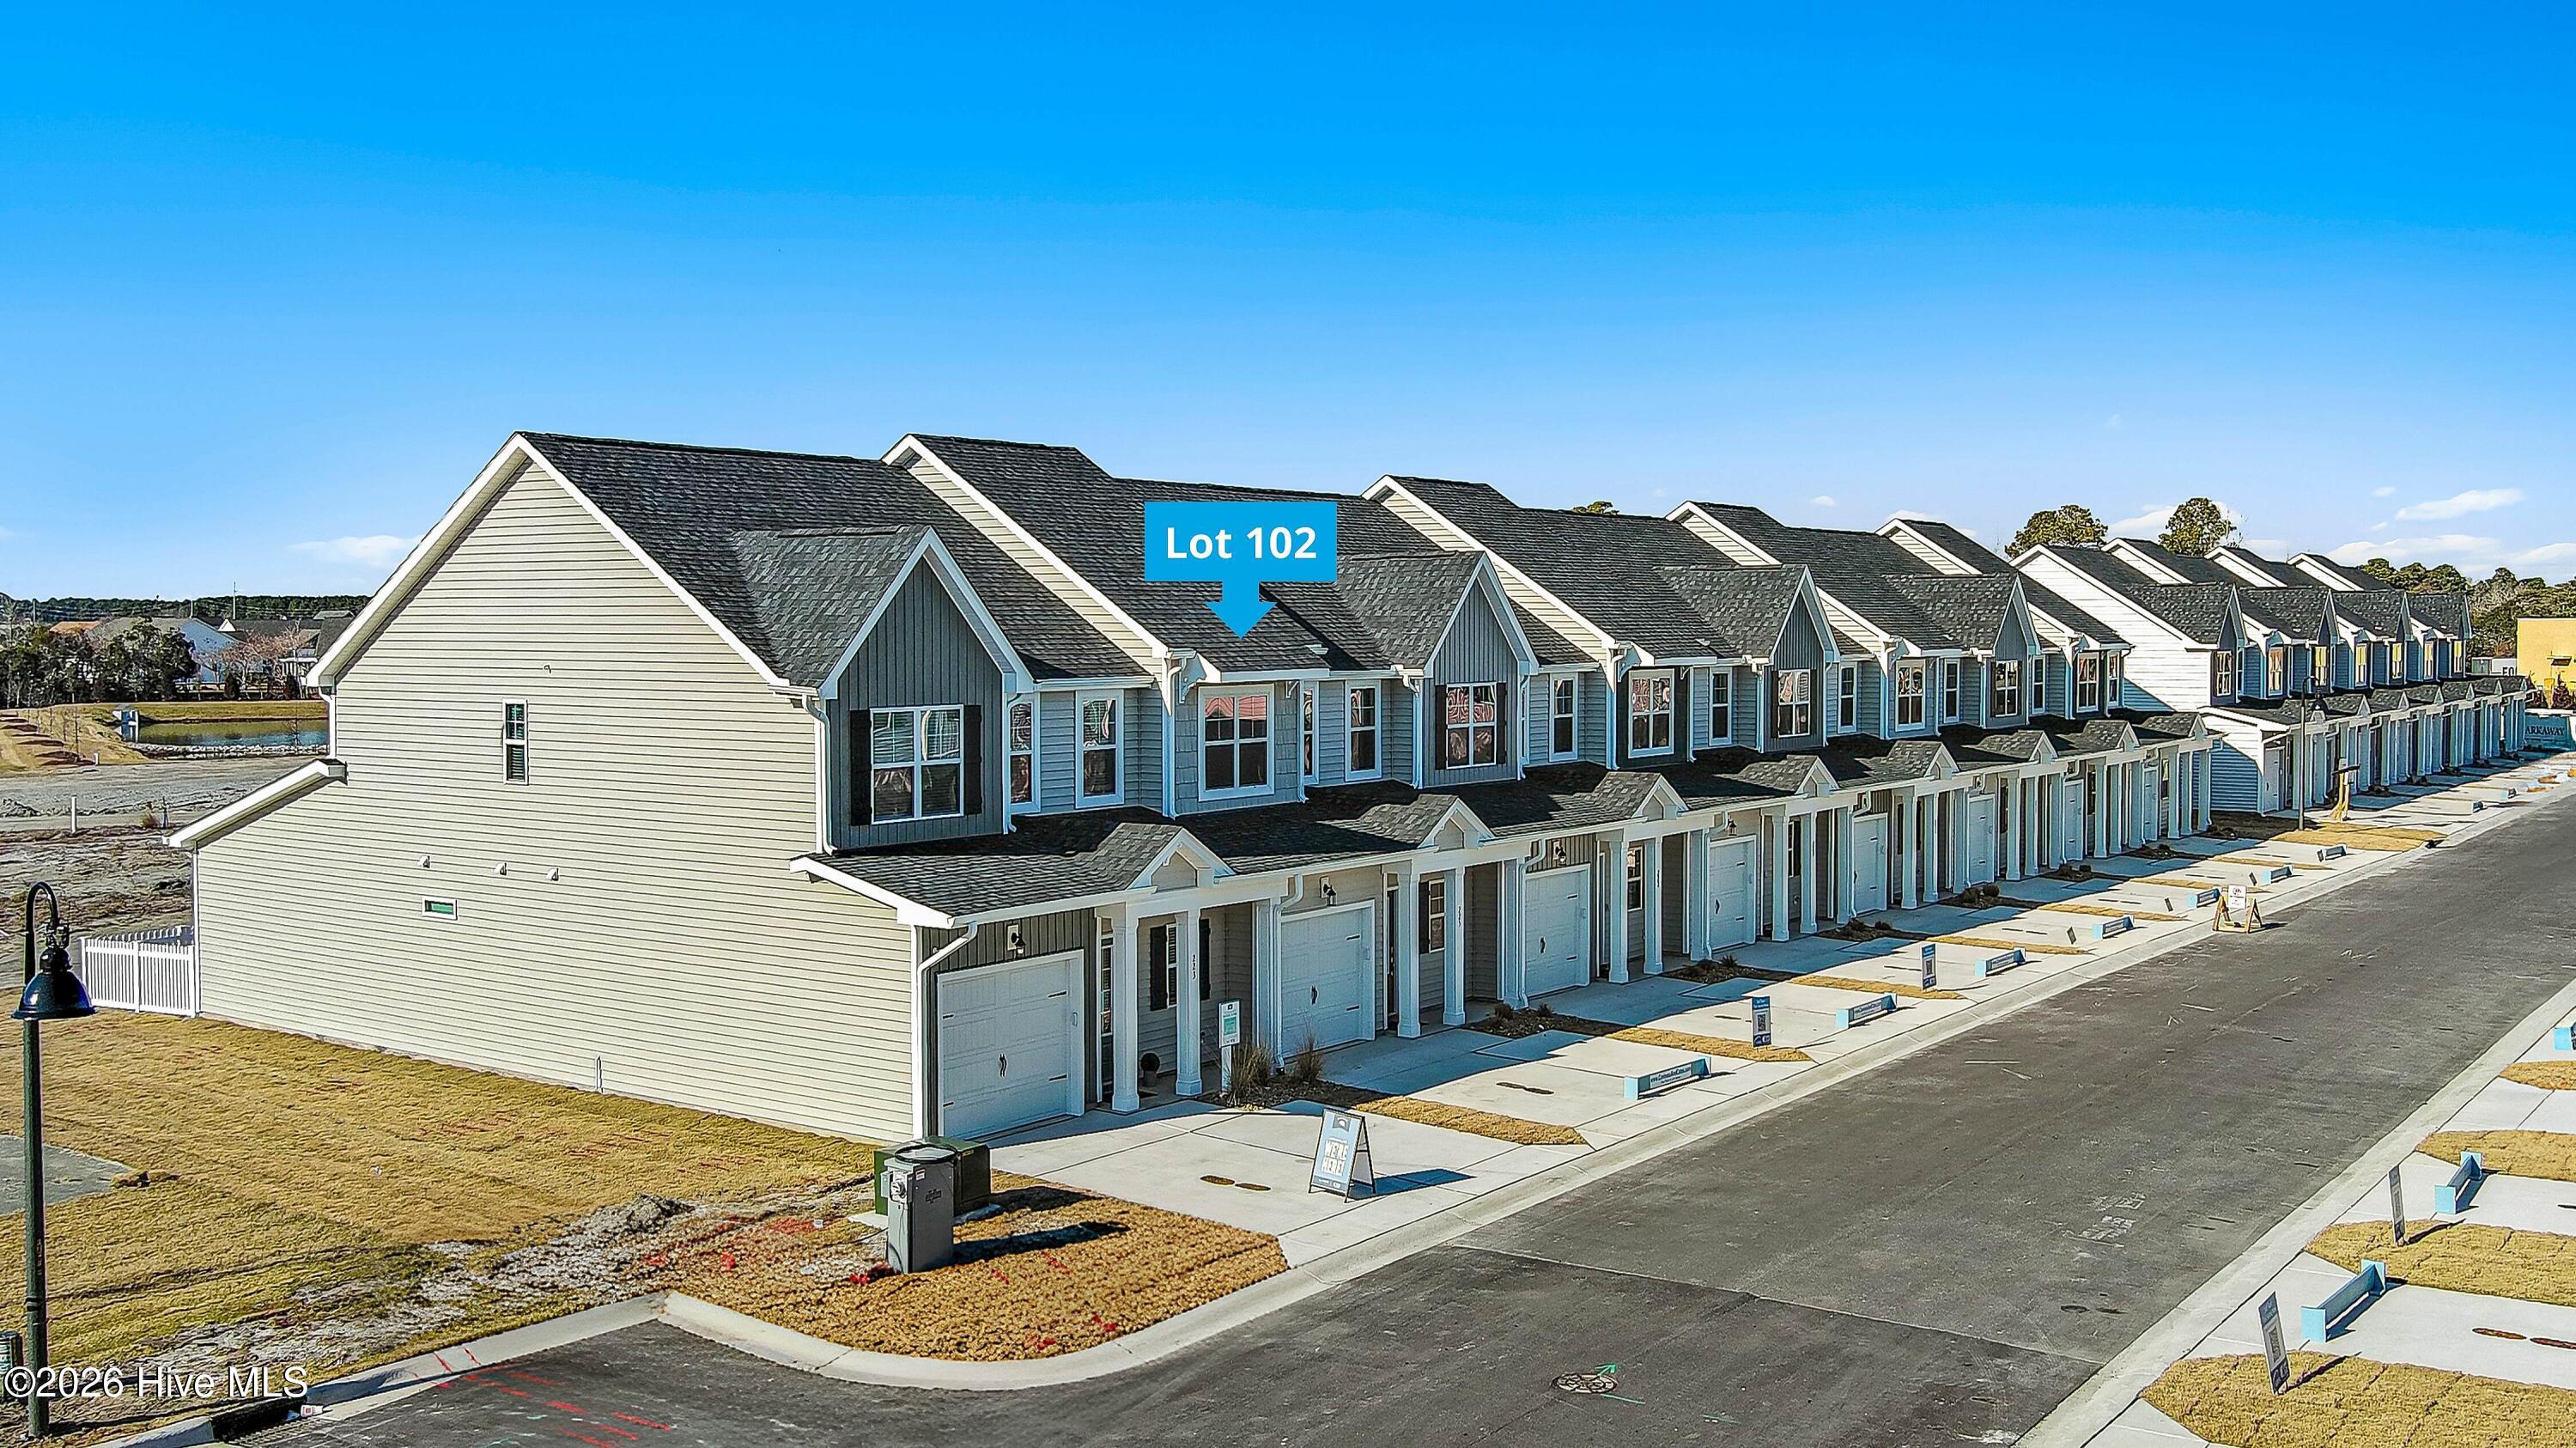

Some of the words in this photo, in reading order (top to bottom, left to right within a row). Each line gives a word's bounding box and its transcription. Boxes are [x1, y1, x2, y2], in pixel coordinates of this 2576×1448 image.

[2525, 725, 2565, 736] ARKAWAY
[1324, 1140, 1349, 1161] WE'RE
[1321, 1156, 1346, 1177] HERE!
